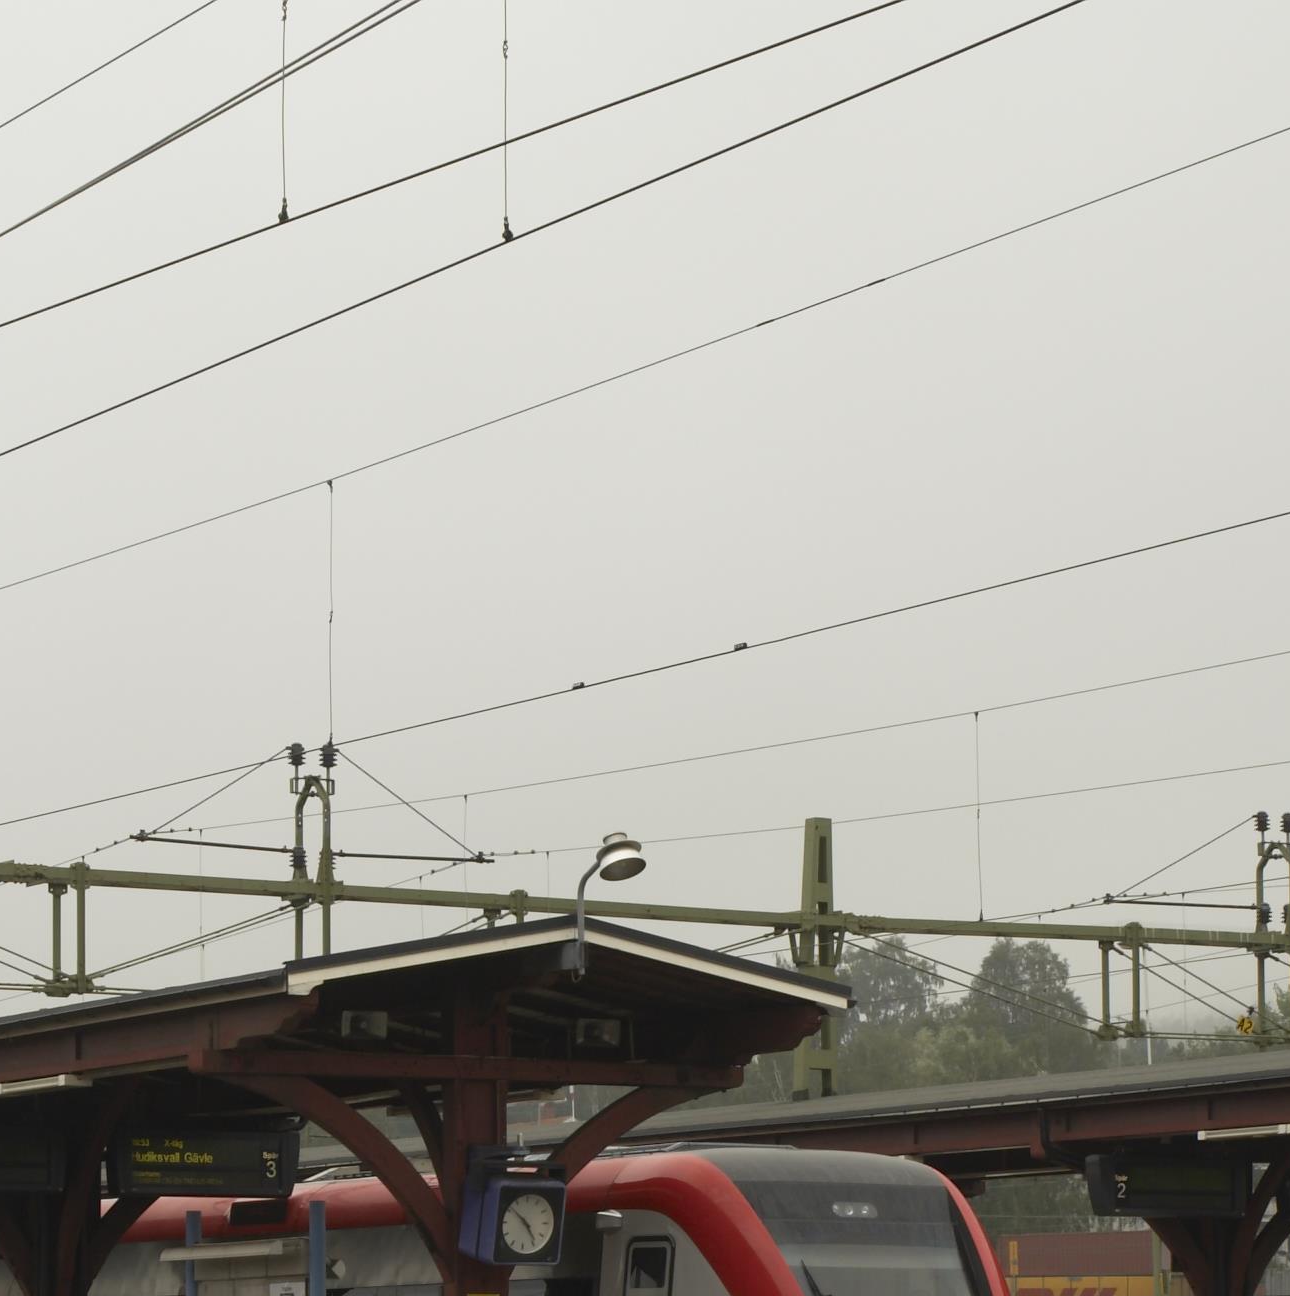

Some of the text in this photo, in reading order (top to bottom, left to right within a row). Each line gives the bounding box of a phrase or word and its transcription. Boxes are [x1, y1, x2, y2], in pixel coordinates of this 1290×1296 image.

[1237, 1017, 1253, 1034] A2
[266, 1161, 277, 1178] 3
[1117, 1183, 1126, 1198] 2
